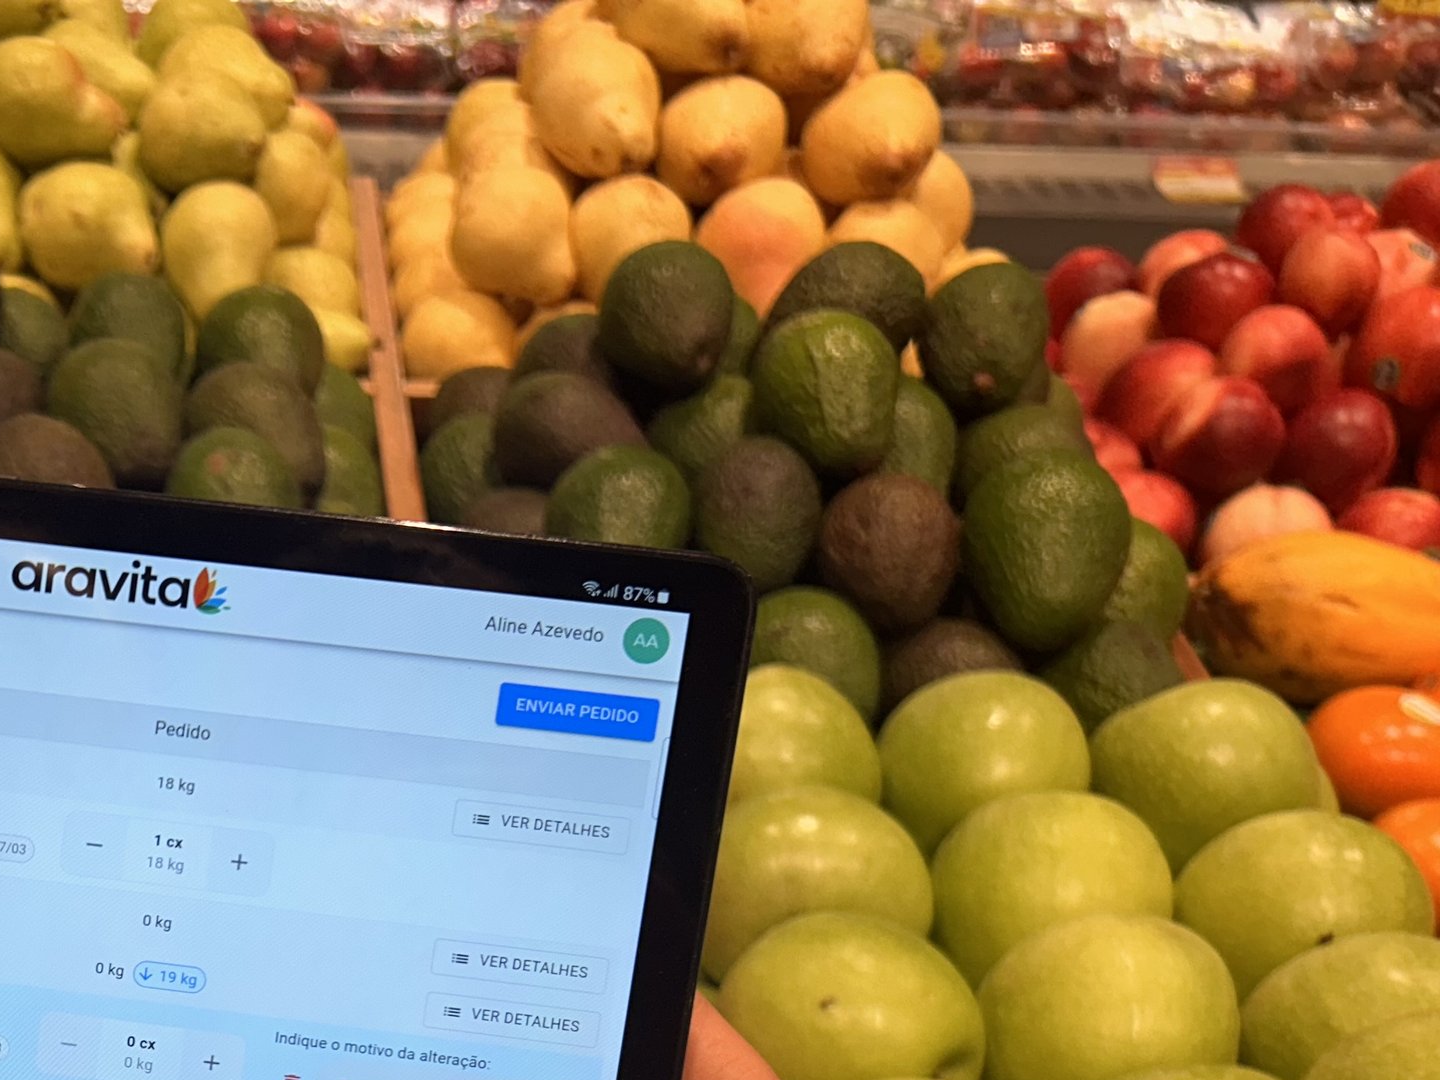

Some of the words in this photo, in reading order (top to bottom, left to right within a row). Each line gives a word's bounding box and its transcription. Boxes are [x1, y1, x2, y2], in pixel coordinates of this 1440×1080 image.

[11, 559, 190, 609] aravita
[623, 586, 655, 603] 87%
[485, 616, 528, 634] Aline
[531, 621, 604, 643] Azevedo
[633, 633, 659, 649] AA
[515, 698, 576, 717] ENVIAR
[579, 705, 639, 724] PEDIDO
[154, 720, 211, 741] Pedido
[157, 776, 175, 790] 18
[178, 778, 196, 796] kg
[502, 815, 530, 829] VER
[534, 818, 610, 839] DETALHES
[154, 835, 161, 847] 1
[166, 837, 183, 849] cx
[147, 856, 164, 869] 18
[167, 857, 185, 875] kg
[142, 914, 152, 927] 0
[155, 915, 173, 932] kg
[95, 962, 104, 974] 0
[108, 963, 125, 980] kg
[480, 954, 508, 969] VER
[512, 958, 588, 978] DETALHES
[160, 970, 177, 983] 19
[180, 972, 198, 989] kg
[472, 1008, 500, 1023] VER
[504, 1012, 581, 1032] DETALHES
[127, 1036, 136, 1047] 0
[139, 1039, 156, 1051] cx
[275, 1032, 328, 1050] Indique
[331, 1040, 340, 1051] o
[345, 1040, 394, 1058] motivo
[397, 1046, 415, 1061] da
[419, 1049, 491, 1070] alteração:
[124, 1057, 133, 1068] 0
[136, 1057, 153, 1074] kg
